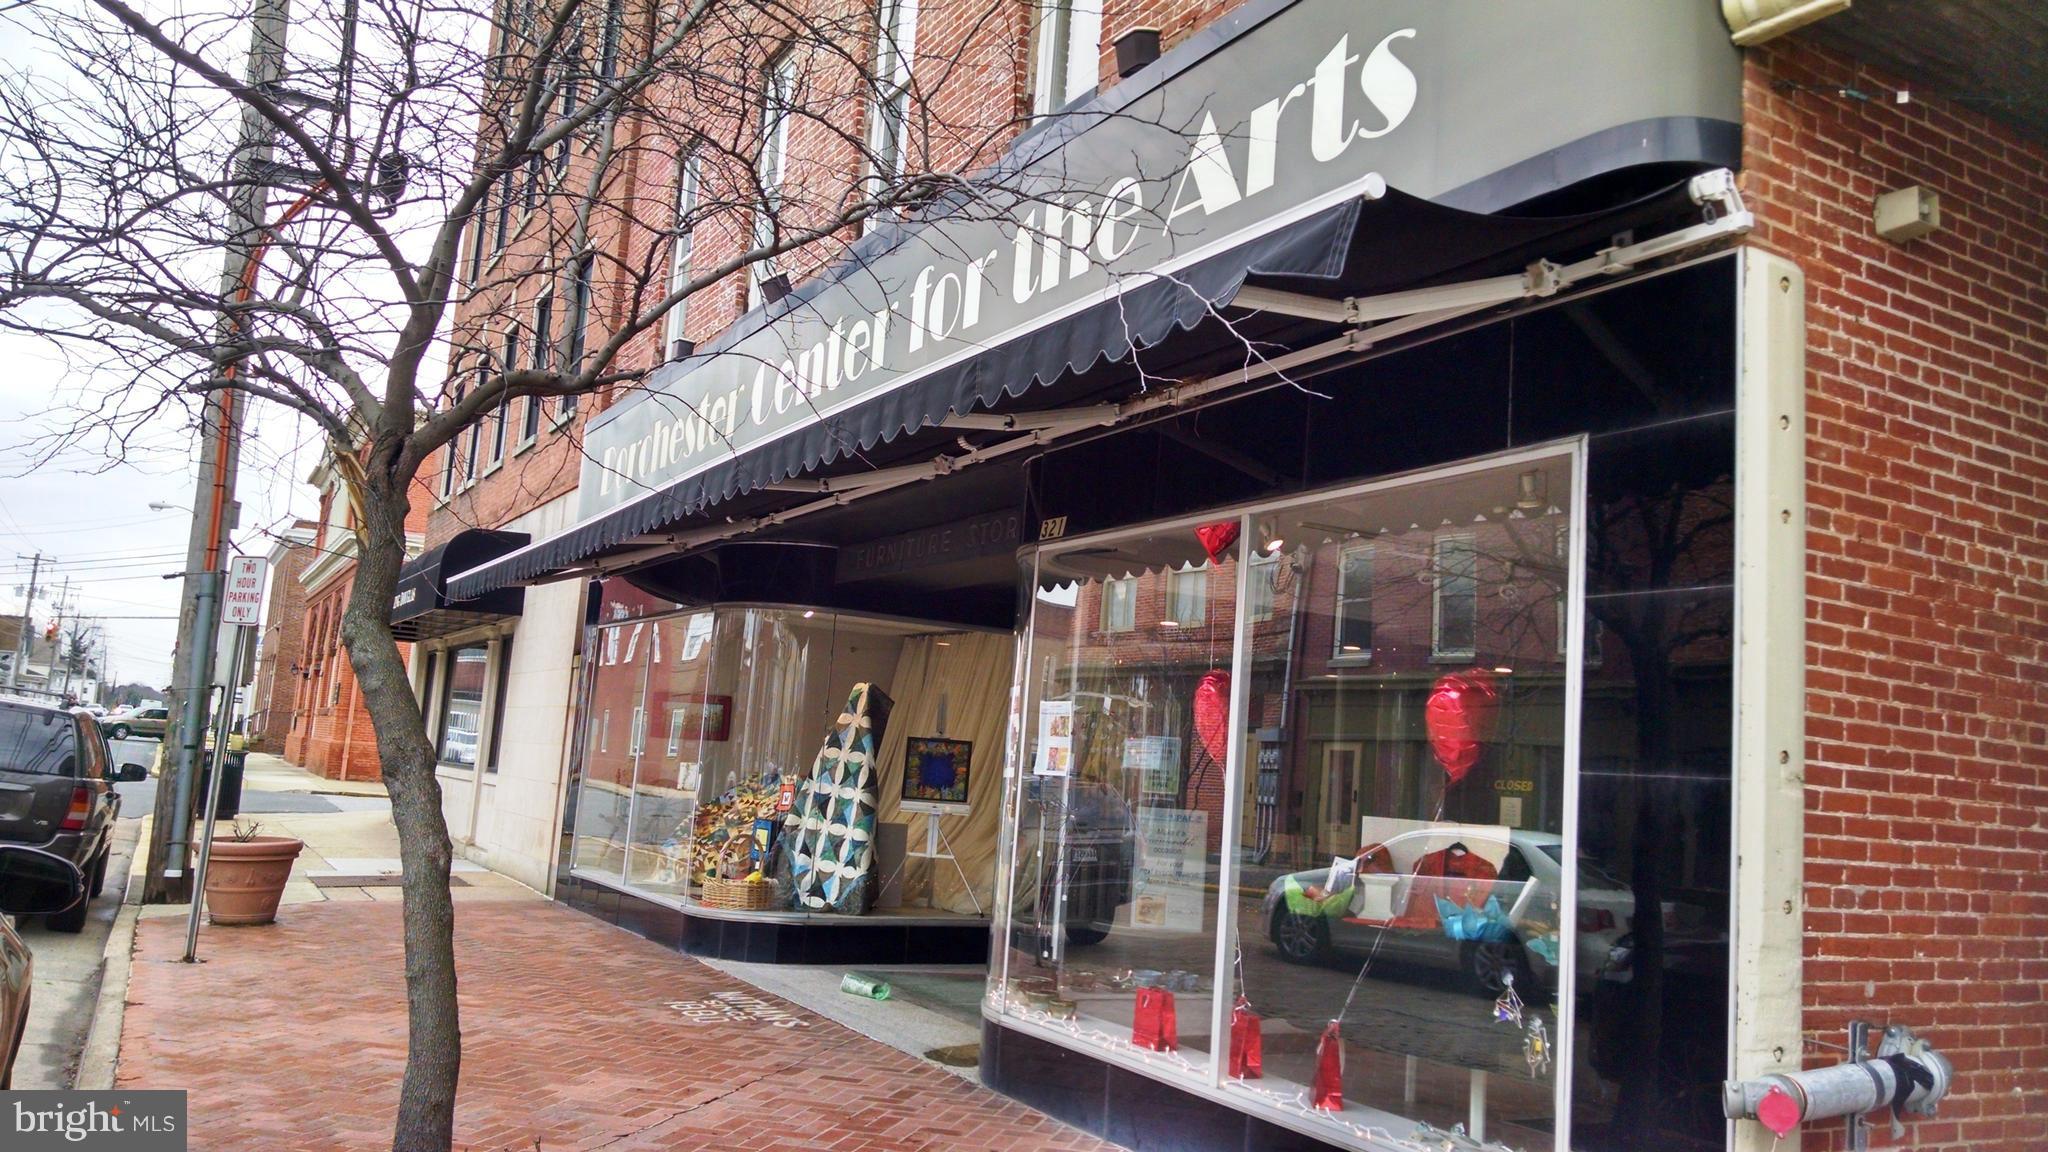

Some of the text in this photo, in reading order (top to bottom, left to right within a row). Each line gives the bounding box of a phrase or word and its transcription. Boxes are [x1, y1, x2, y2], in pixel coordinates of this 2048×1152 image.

[752, 301, 899, 425] Center
[909, 248, 998, 353] for
[1011, 177, 1143, 303] the
[1163, 28, 1418, 237] Arts
[1041, 518, 1064, 538] 321
[856, 516, 1018, 569] FURNITURE STOR
[242, 562, 257, 574] TWO
[236, 577, 257, 588] HOUR
[228, 591, 260, 604] PARKING
[232, 606, 252, 618] ONLY
[663, 1000, 730, 1023] 1880
